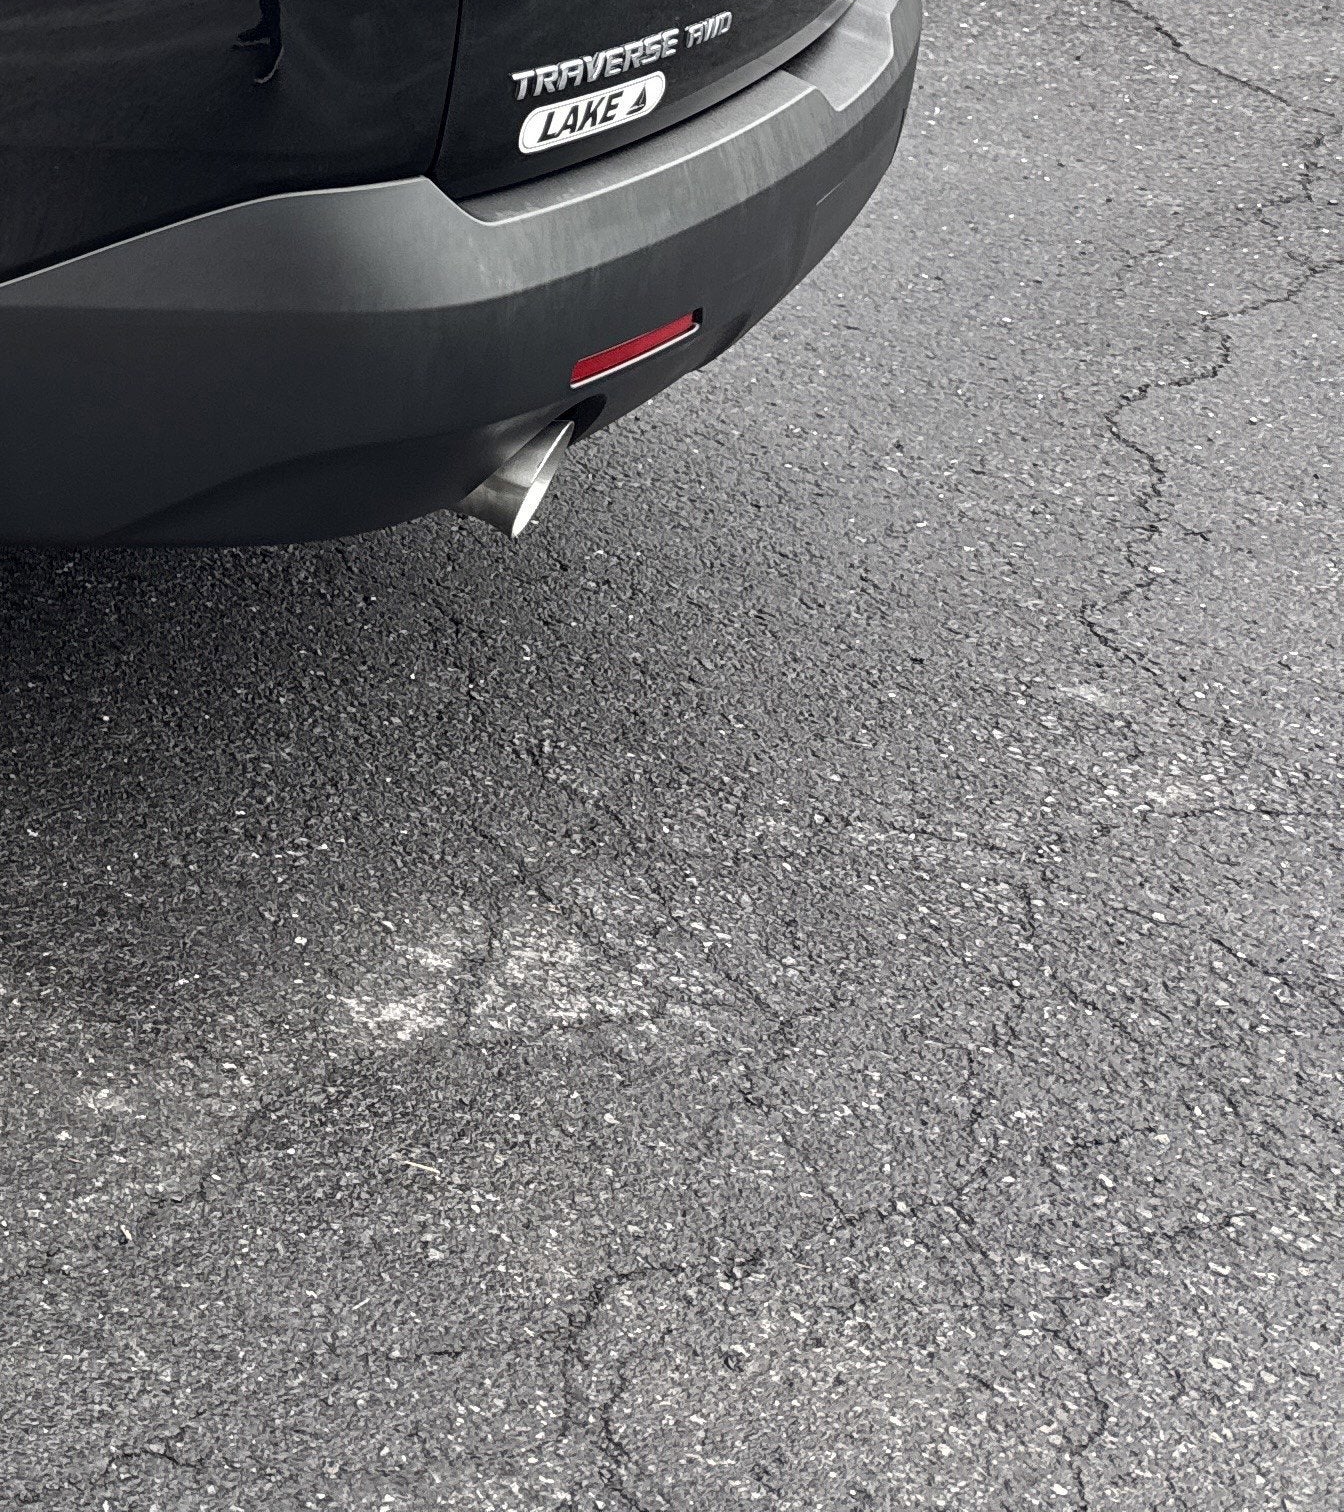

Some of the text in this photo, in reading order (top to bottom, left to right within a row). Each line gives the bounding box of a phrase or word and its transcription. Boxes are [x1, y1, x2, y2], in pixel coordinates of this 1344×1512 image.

[511, 10, 733, 101] TRAVERSE AWD
[537, 90, 624, 144] LAKE
